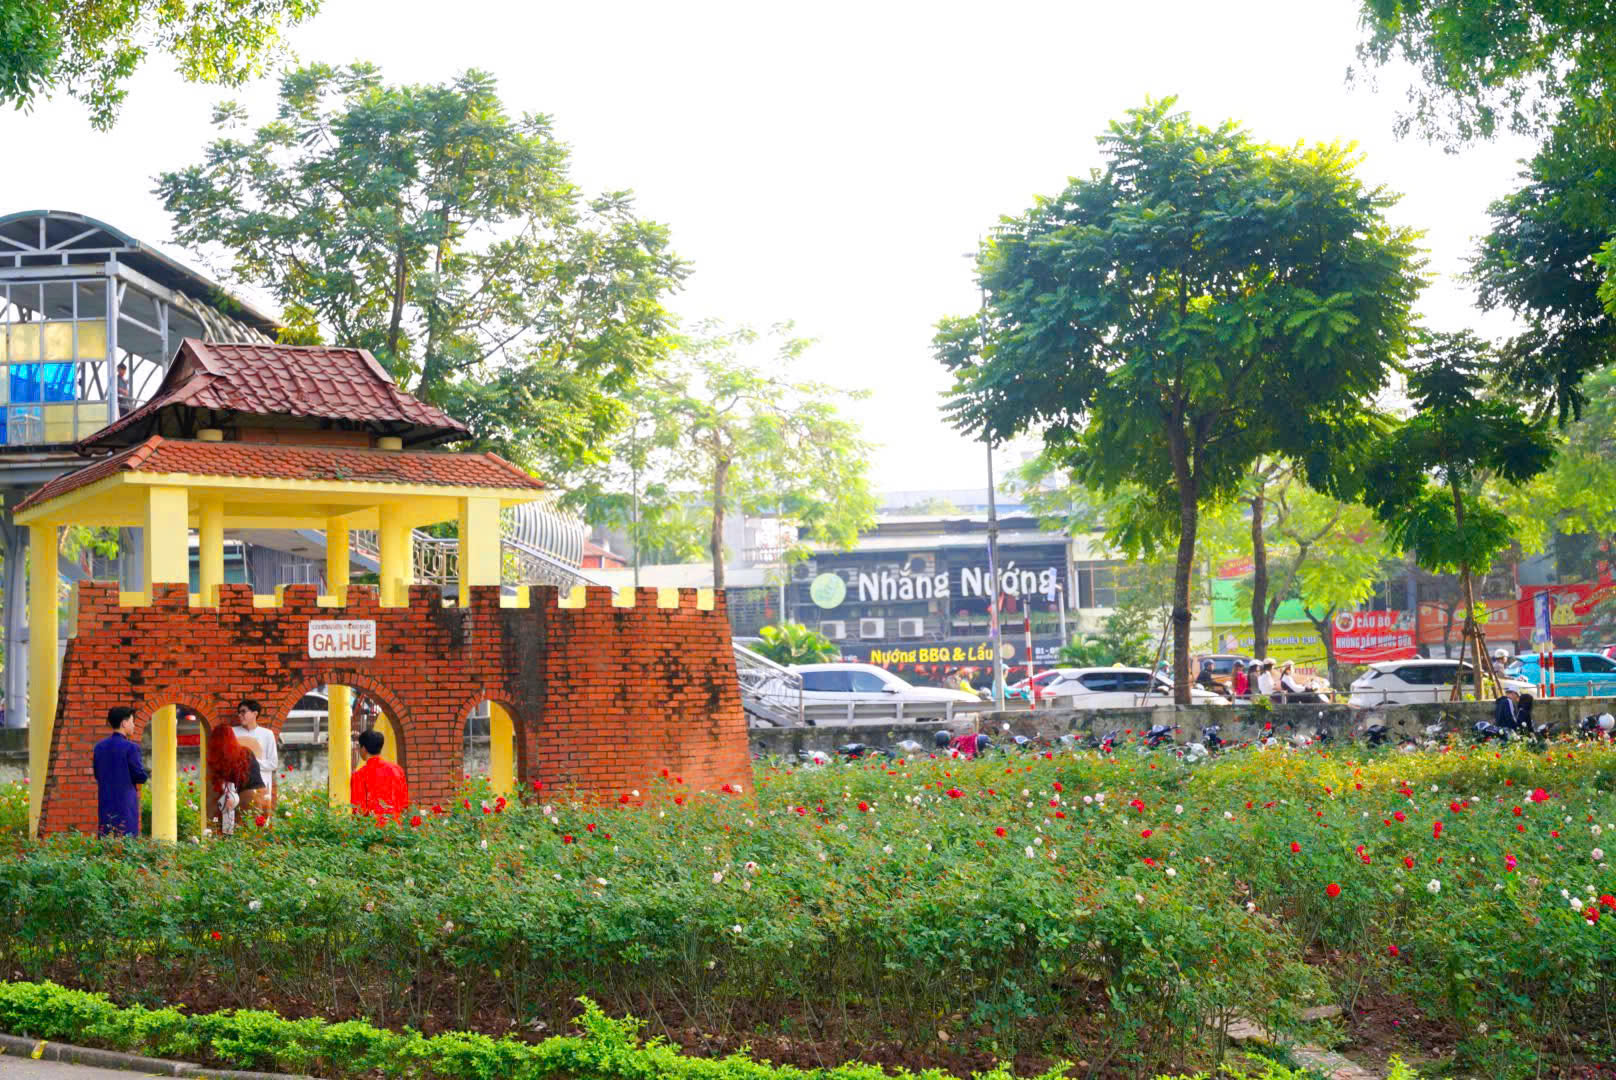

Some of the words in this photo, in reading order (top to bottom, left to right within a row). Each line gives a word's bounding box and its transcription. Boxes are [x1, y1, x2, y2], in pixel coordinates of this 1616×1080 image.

[859, 560, 950, 601] Nhắng
[961, 560, 1054, 598] Nướng
[871, 648, 916, 664] Nướng
[919, 648, 950, 662] BBQ
[952, 647, 966, 661] &
[968, 642, 993, 661] Lẩu
